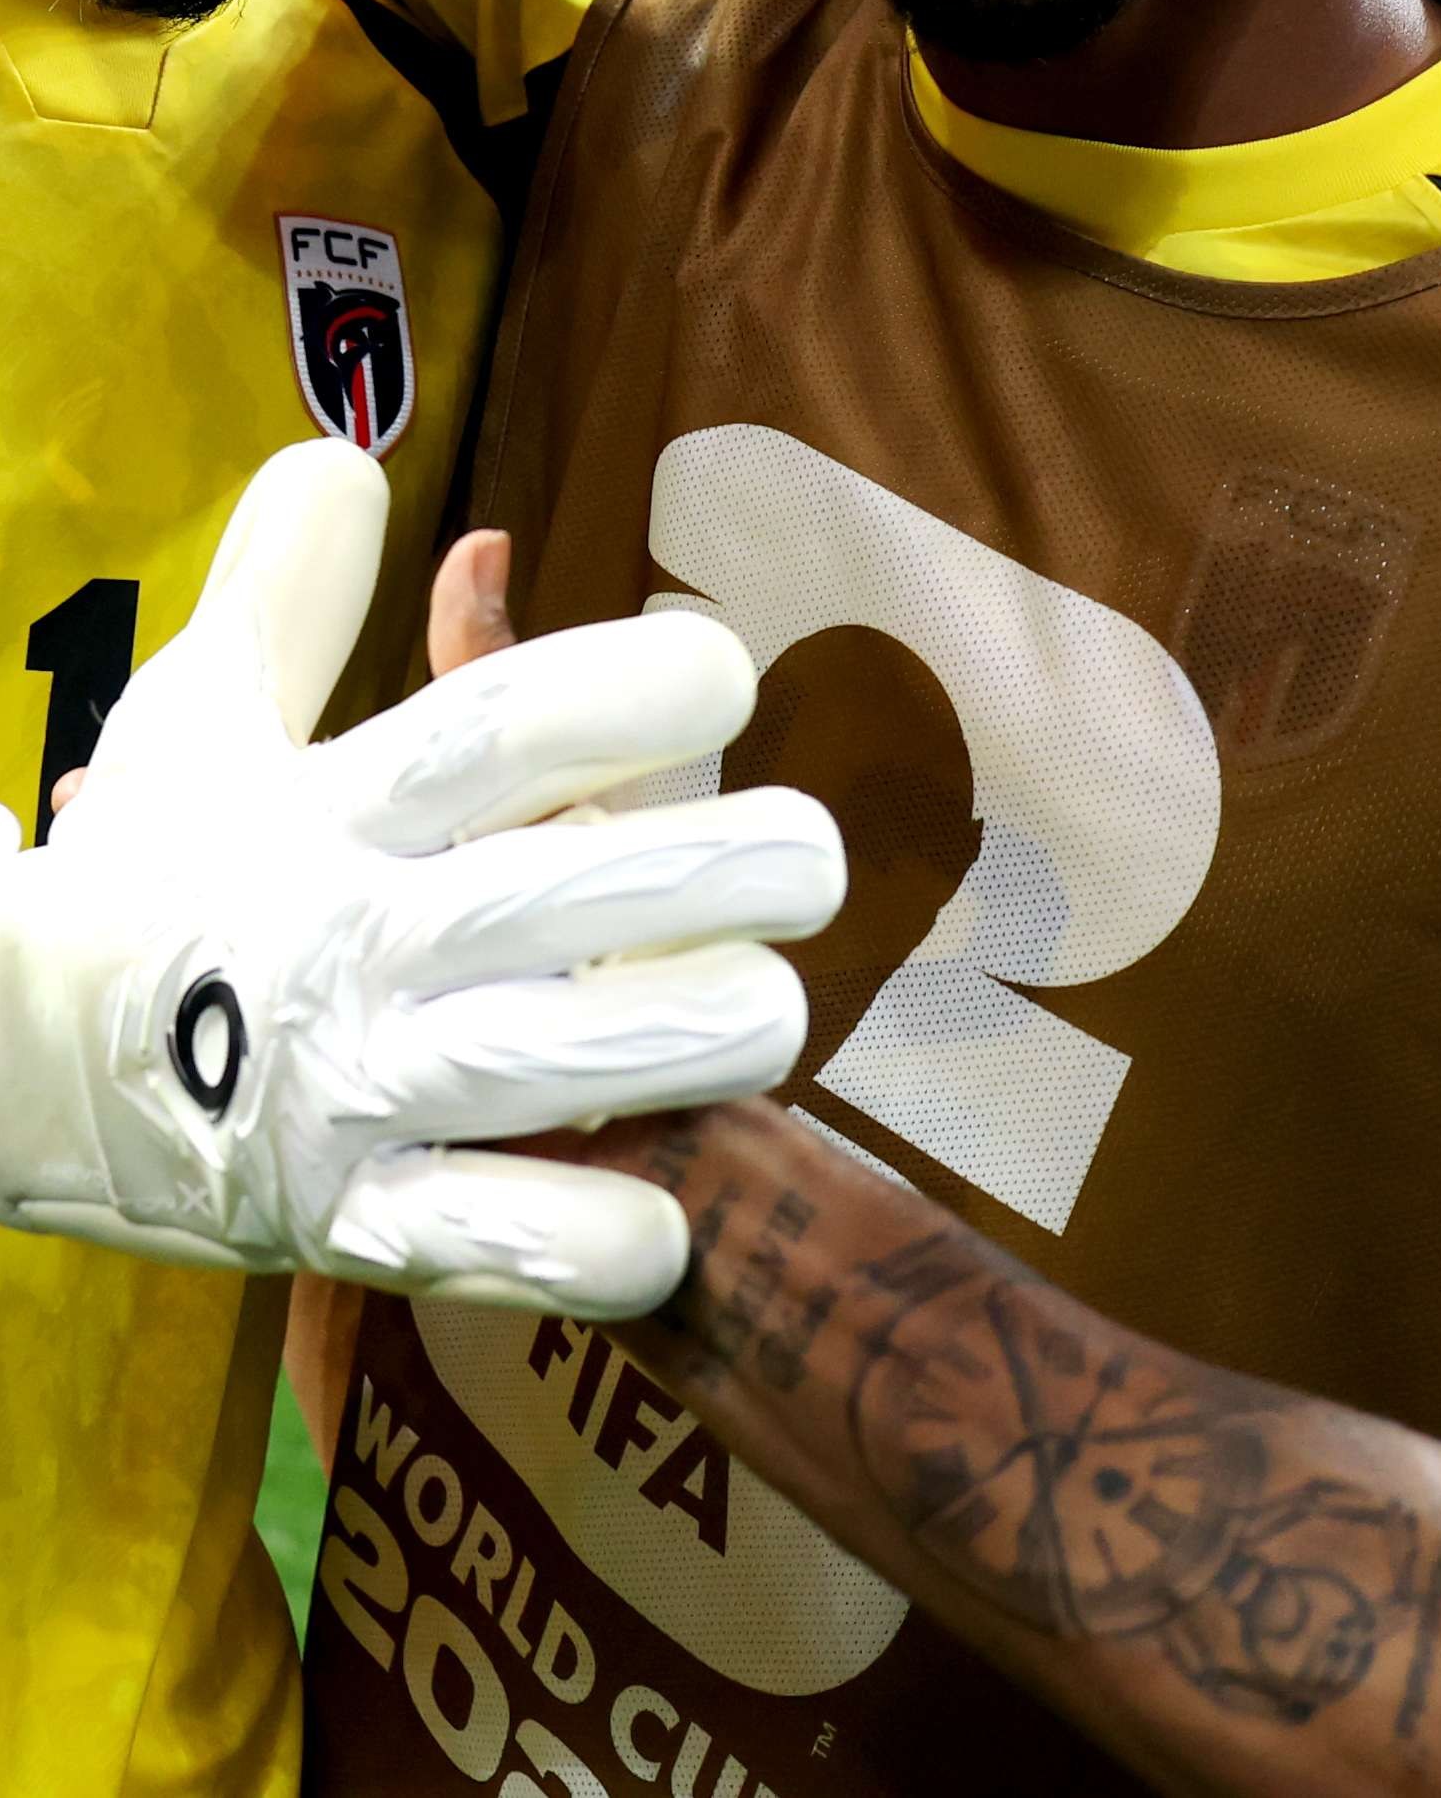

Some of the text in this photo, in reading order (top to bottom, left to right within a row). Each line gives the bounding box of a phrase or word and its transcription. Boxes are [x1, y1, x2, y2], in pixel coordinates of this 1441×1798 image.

[291, 228, 389, 269] FCF
[529, 1316, 730, 1557] FIFA
[354, 1374, 782, 1798] WORLD CU
